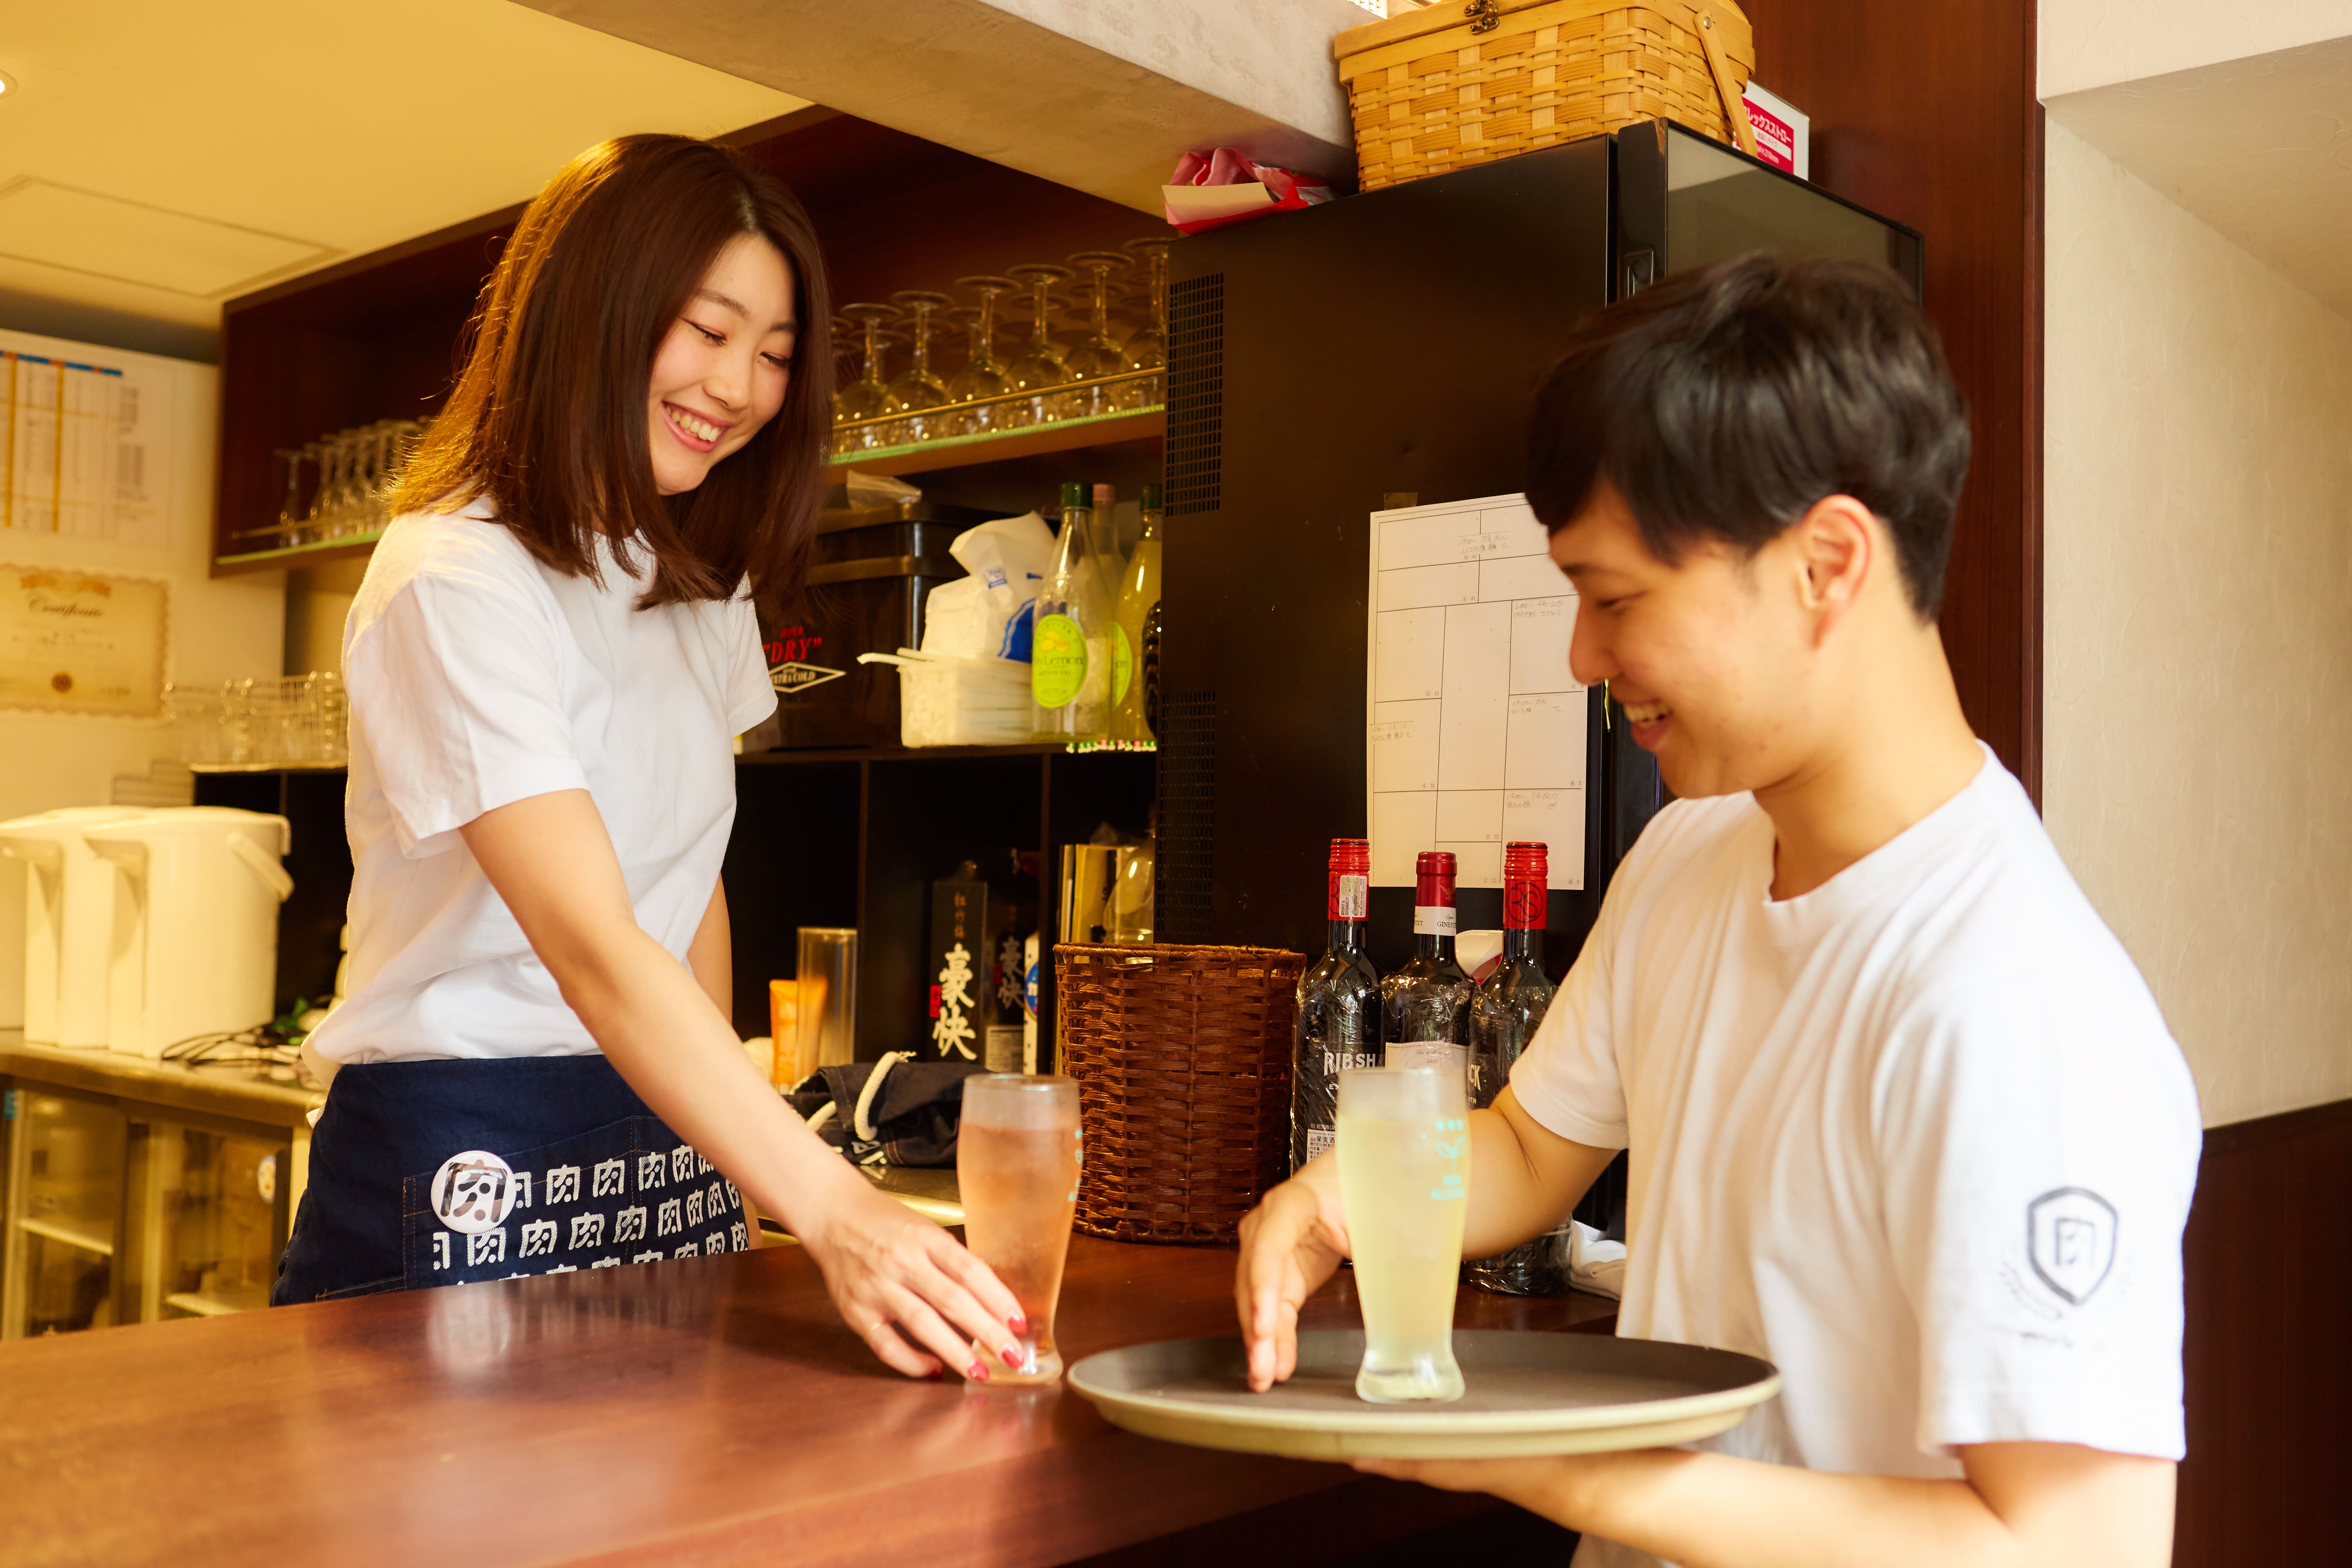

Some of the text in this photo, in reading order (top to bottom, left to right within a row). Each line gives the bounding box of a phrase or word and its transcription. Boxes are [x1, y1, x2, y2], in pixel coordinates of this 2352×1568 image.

[1744, 105, 1792, 143] レックスストロー
[770, 671, 816, 685] XTRA COLD
[932, 942, 978, 1061] 豪快
